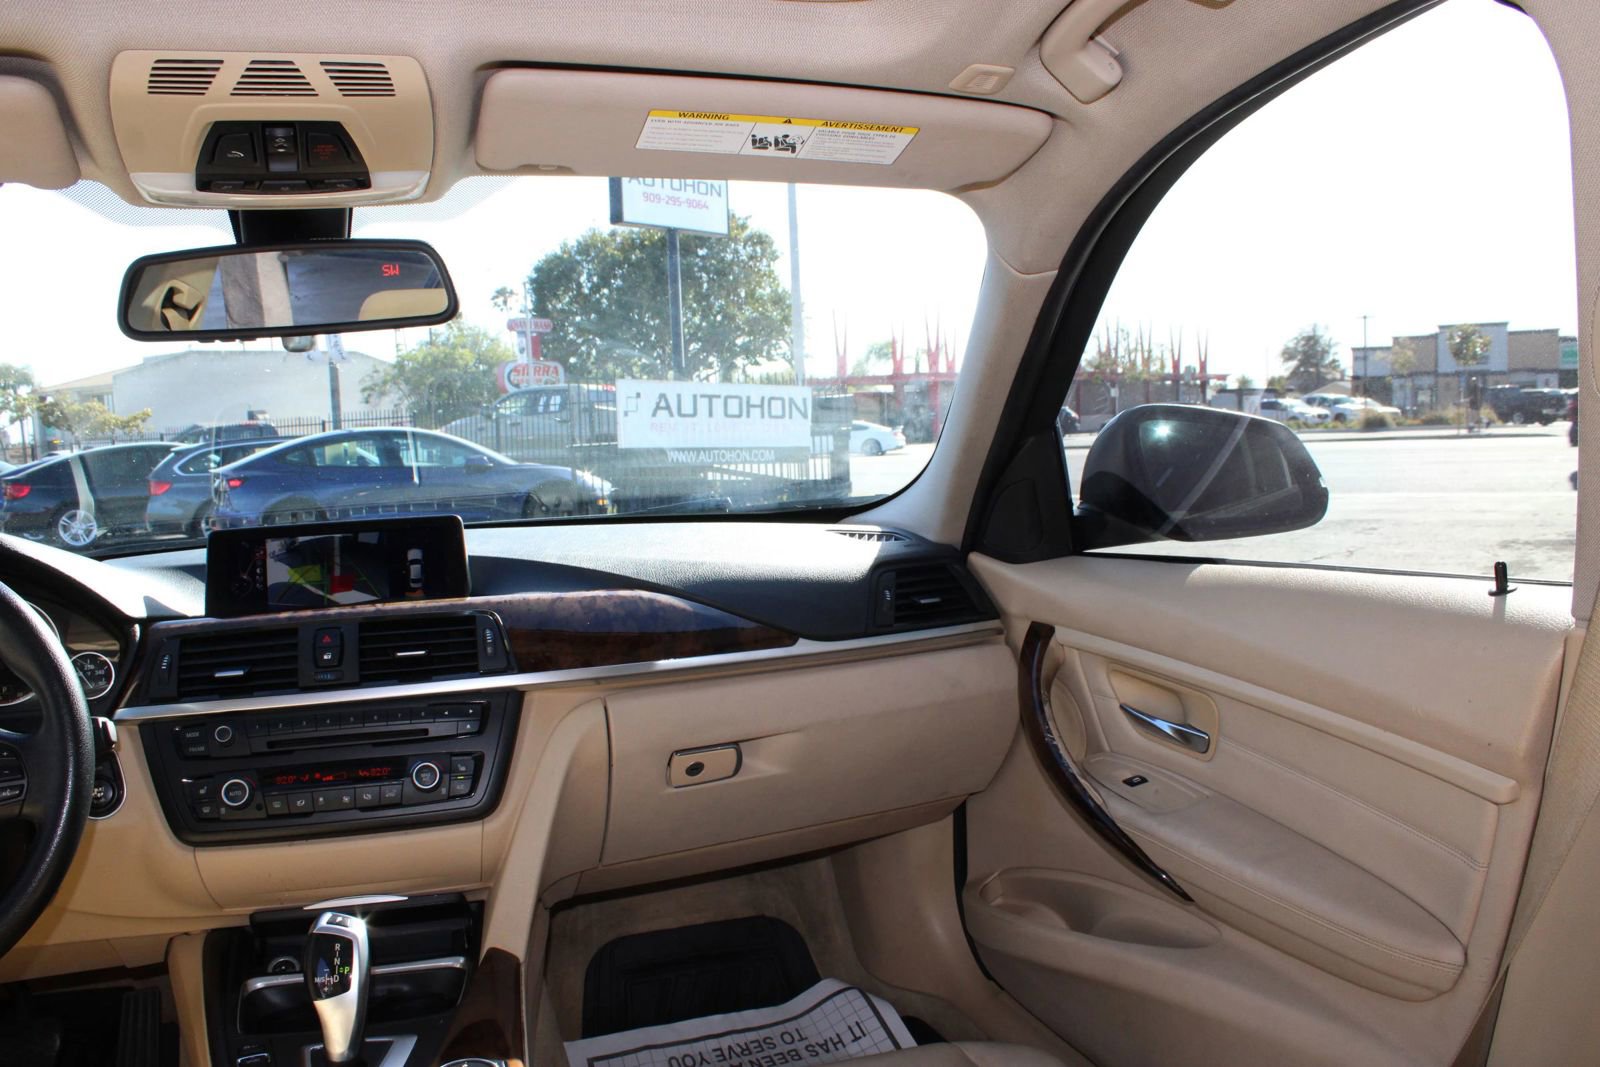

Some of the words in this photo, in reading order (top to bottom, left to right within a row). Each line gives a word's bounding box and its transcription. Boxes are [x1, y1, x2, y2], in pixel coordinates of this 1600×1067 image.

[678, 112, 730, 120] WARNING
[821, 121, 904, 133] AVERTISSEMENT
[628, 177, 722, 197] AUTOHON
[642, 191, 709, 209] 909-295-9064
[382, 264, 399, 276] SW
[651, 392, 809, 419] AUTOHON
[666, 449, 776, 464] WWW.AUTOHON.COM
[335, 943, 340, 951] R
[334, 957, 340, 965] N
[344, 966, 350, 974] P
[333, 974, 339, 983] D
[780, 1027, 808, 1045] TO
[848, 1021, 868, 1043] IT
[712, 1035, 778, 1061] SERVE
[804, 1033, 846, 1057] HAS
[668, 1053, 712, 1067] YOU
[746, 1051, 804, 1067] BEEN
